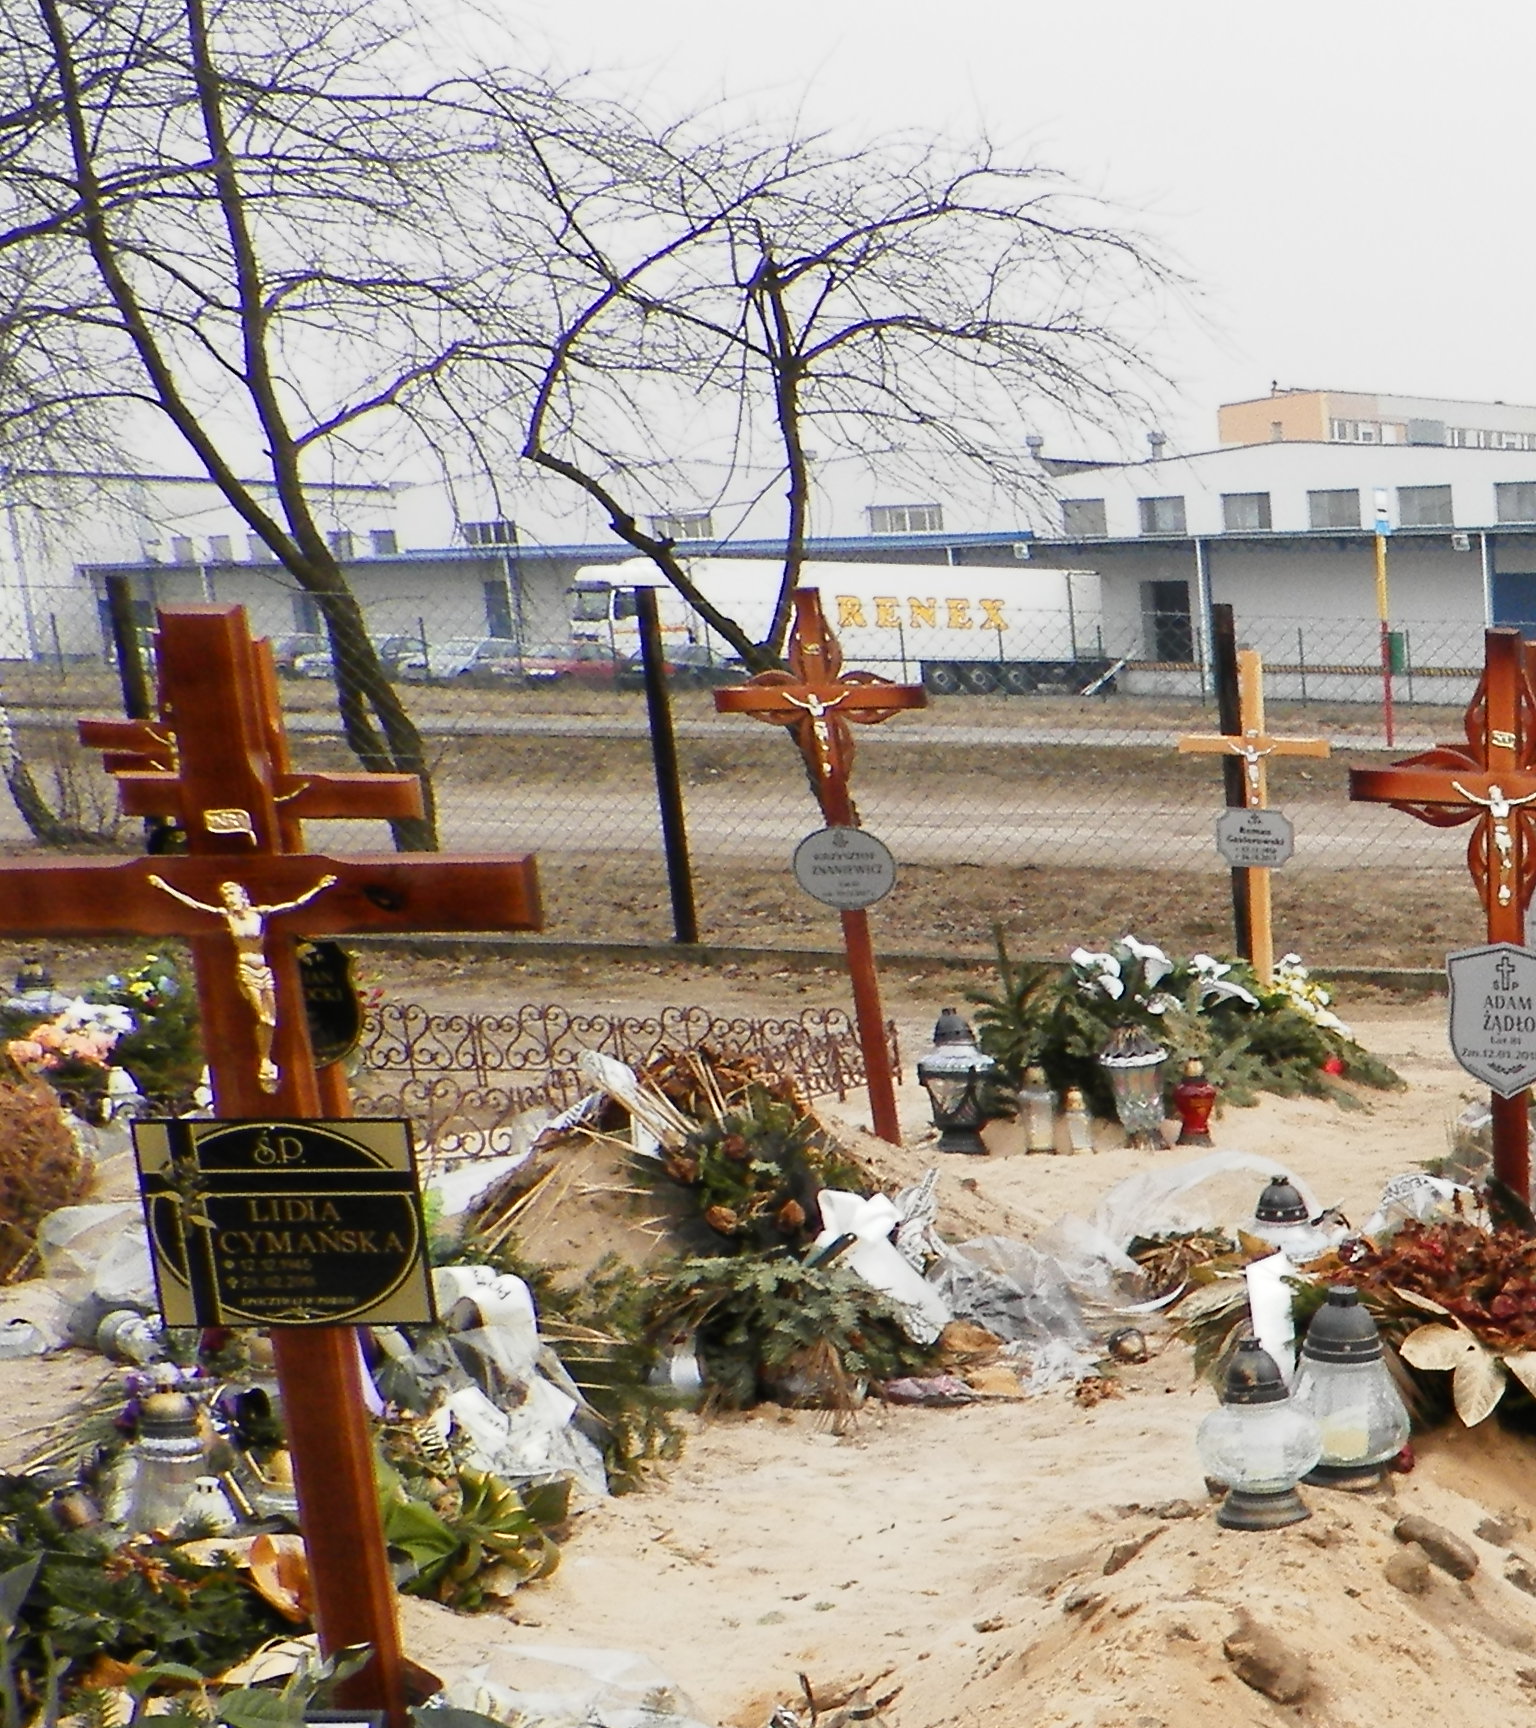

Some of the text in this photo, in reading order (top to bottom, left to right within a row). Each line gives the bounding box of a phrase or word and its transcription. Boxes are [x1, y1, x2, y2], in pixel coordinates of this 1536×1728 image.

[835, 595, 1008, 631] RENEX
[1484, 995, 1532, 1010] ADAM
[1483, 1010, 1536, 1035] ŻĄDŁO
[250, 1199, 343, 1222] LIDIA
[219, 1225, 405, 1254] CYMAŃSKA
